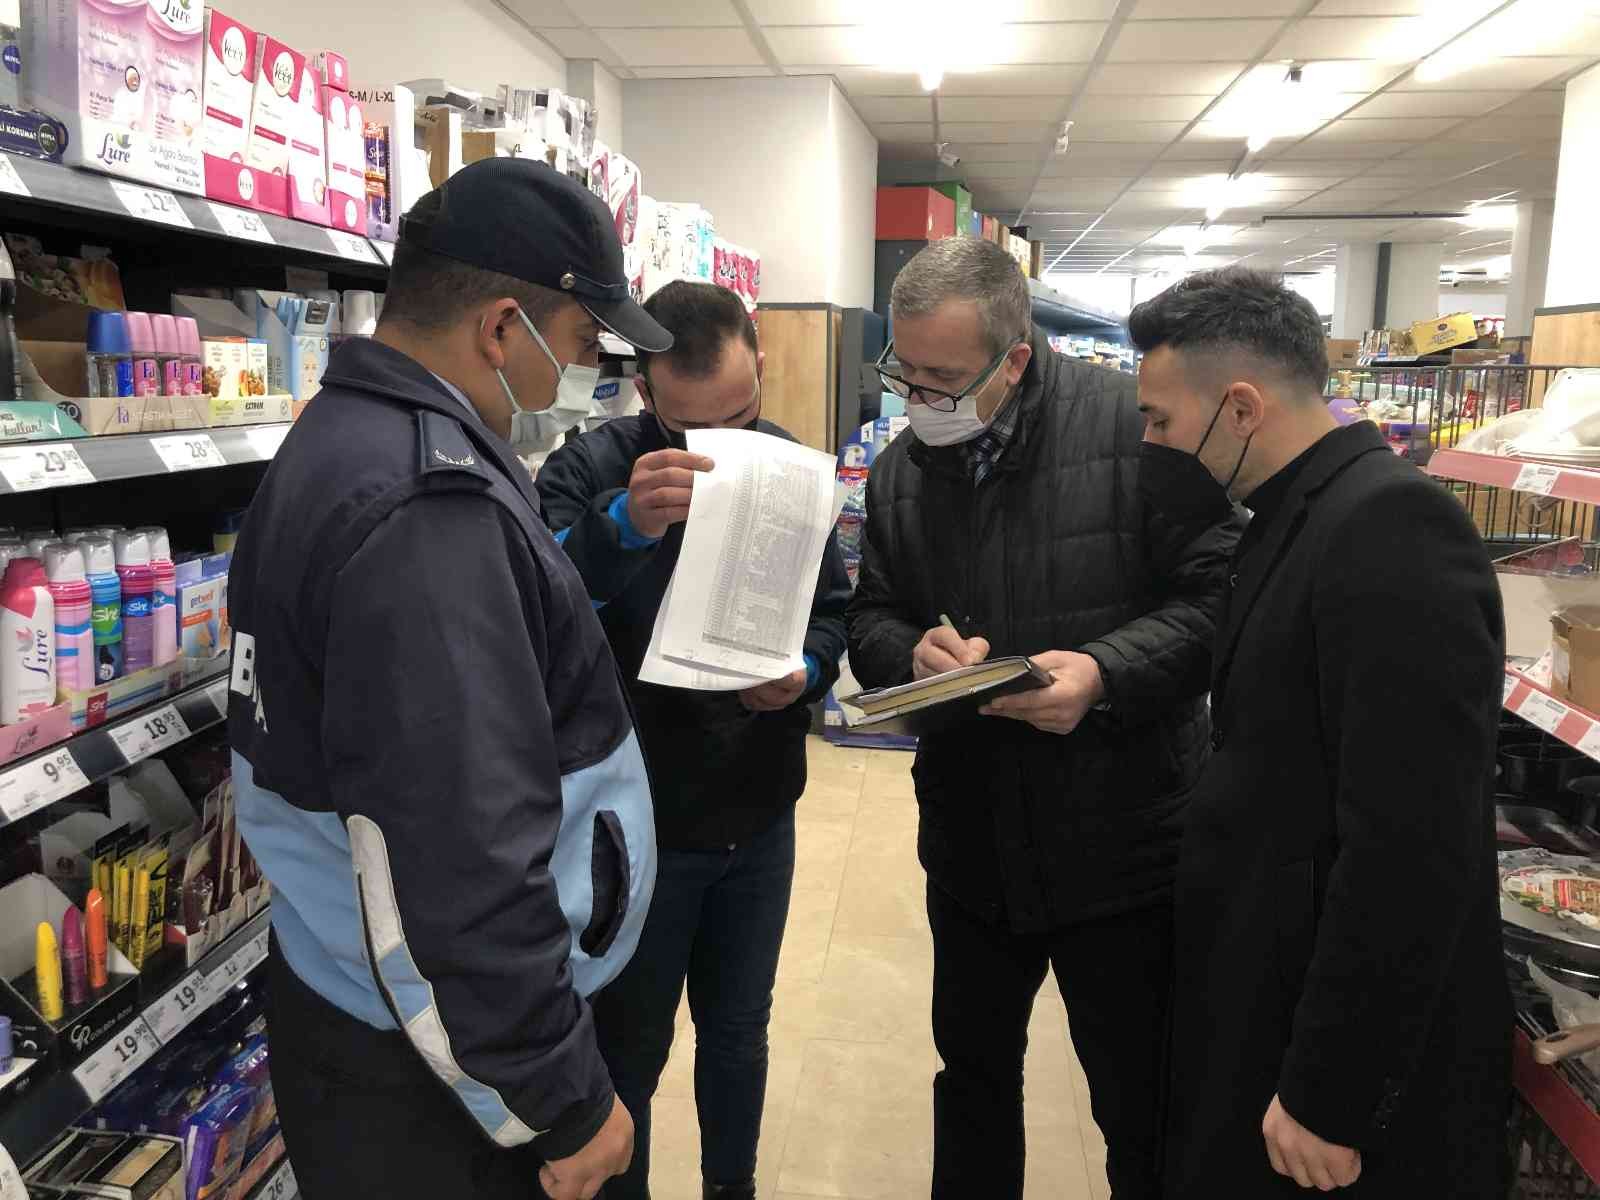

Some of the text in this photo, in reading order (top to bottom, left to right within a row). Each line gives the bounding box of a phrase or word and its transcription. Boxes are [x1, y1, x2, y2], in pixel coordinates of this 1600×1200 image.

[375, 92, 396, 102] L-XL
[96, 133, 130, 165] Lure
[23, 629, 52, 682] Lure
